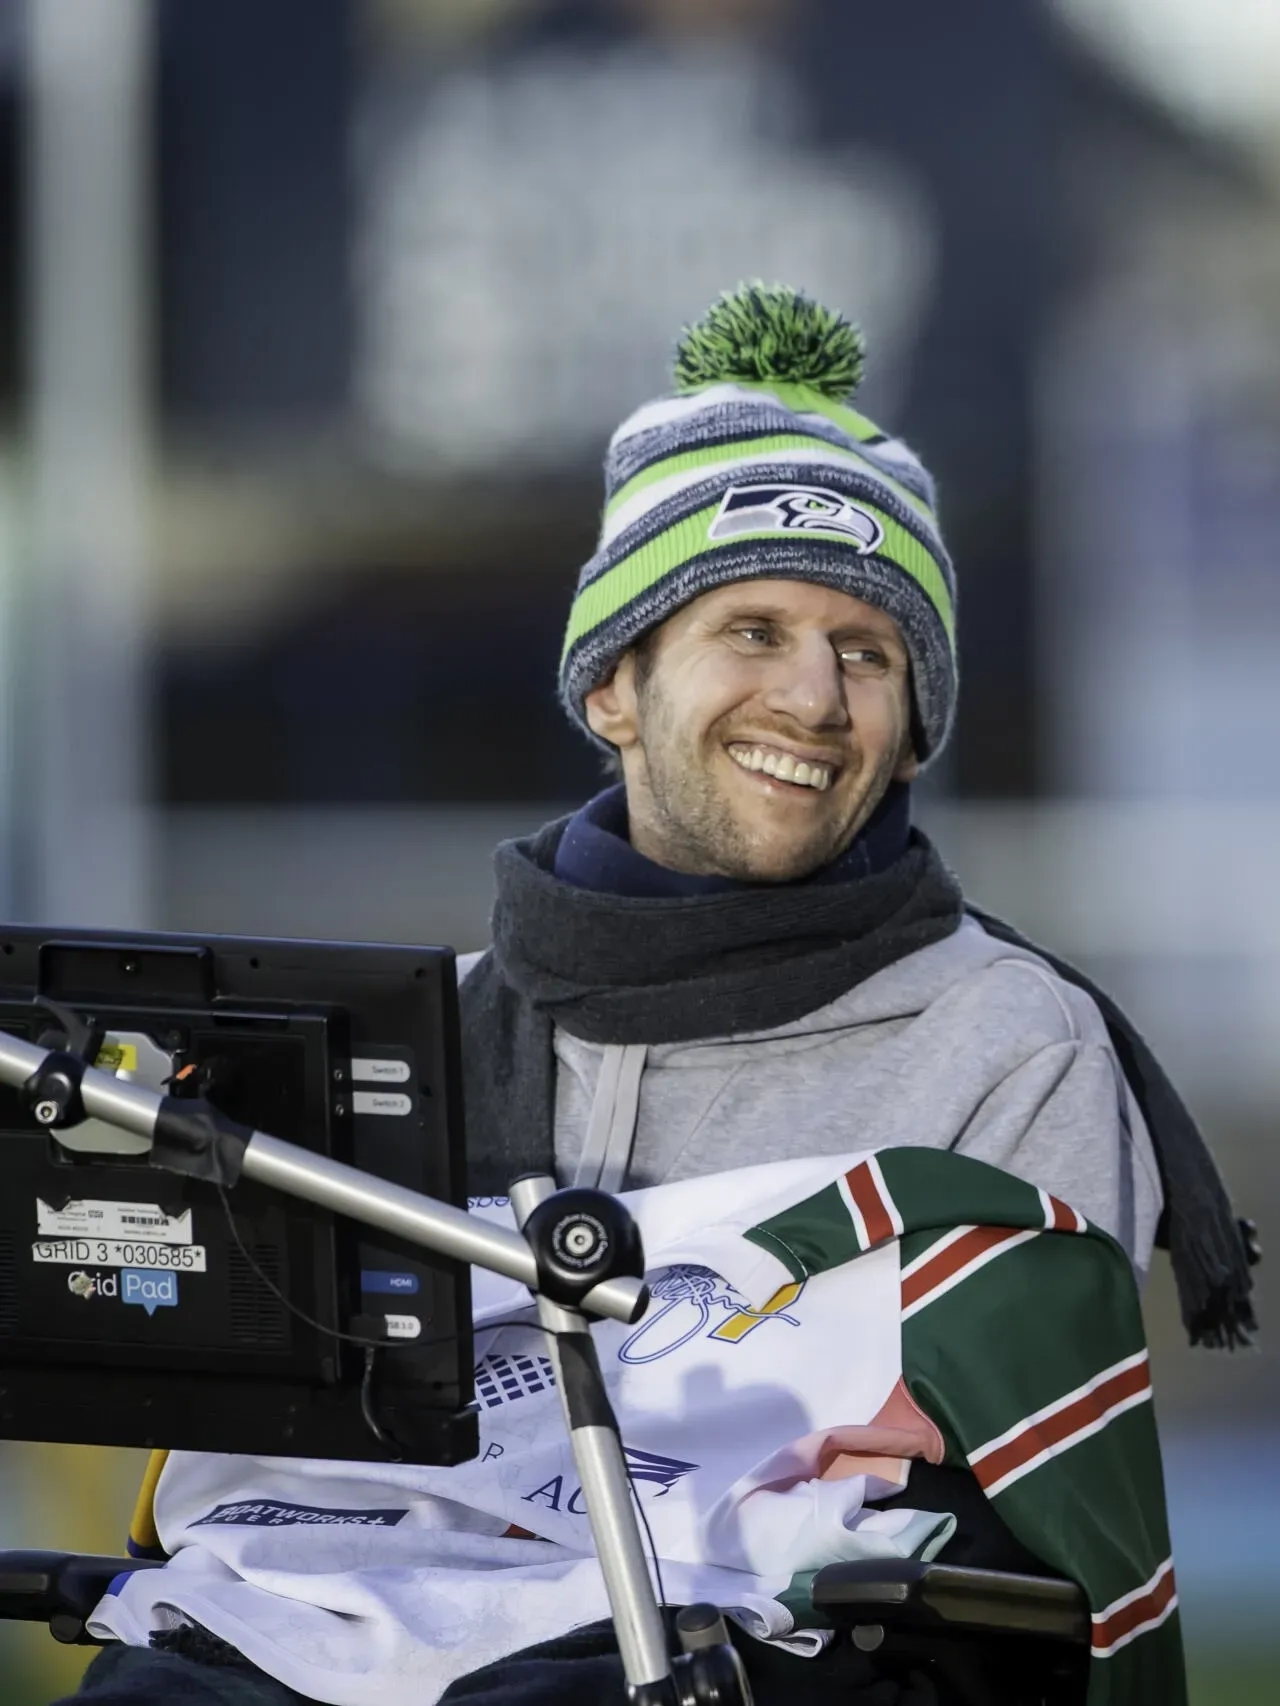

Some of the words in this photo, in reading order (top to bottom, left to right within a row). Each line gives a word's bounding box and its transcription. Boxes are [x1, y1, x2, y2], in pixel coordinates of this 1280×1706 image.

[36, 1241, 91, 1261] GRID
[96, 1242, 109, 1262] 3
[126, 1274, 173, 1300] Pad
